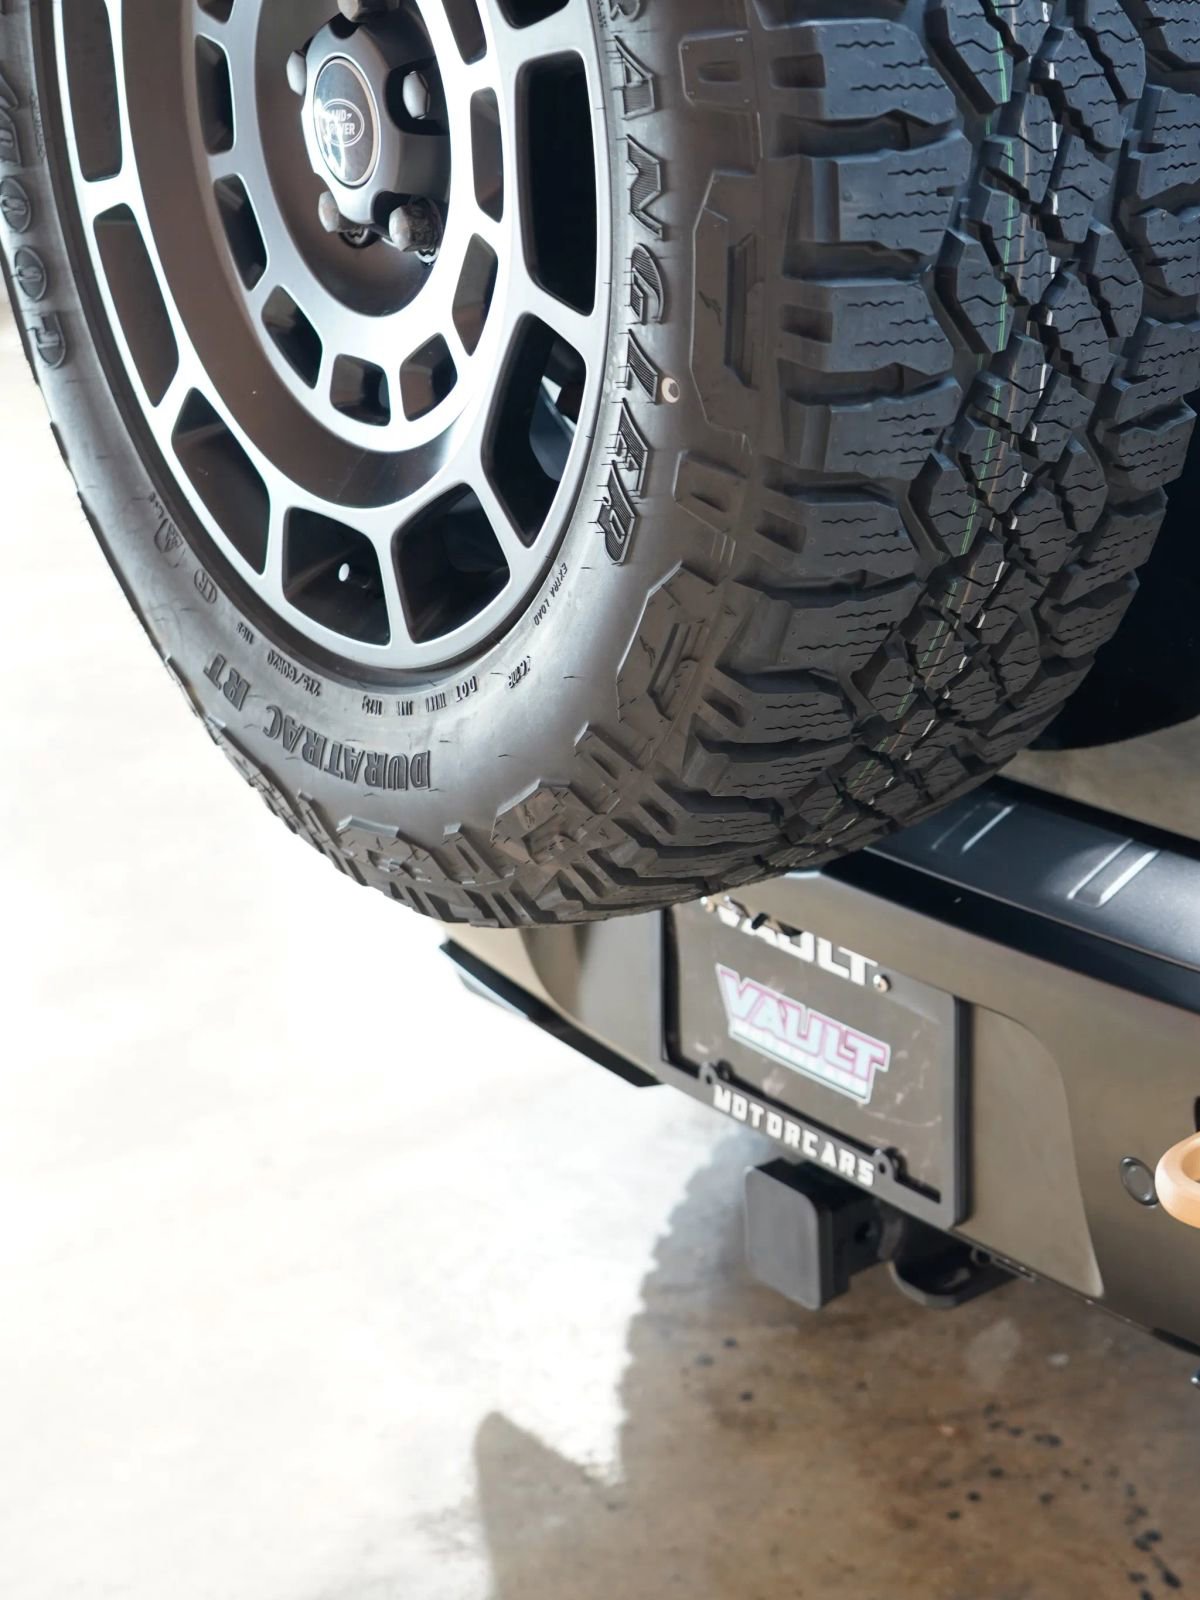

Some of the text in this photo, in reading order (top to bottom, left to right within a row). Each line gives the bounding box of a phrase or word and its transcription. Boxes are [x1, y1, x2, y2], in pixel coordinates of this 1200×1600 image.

[533, 562, 568, 626] EXTRA LOAD
[203, 652, 432, 792] DURATRAC RT
[456, 675, 479, 703] DOT
[718, 966, 888, 1082] VAULT
[712, 1083, 875, 1188] MOTORCARS
